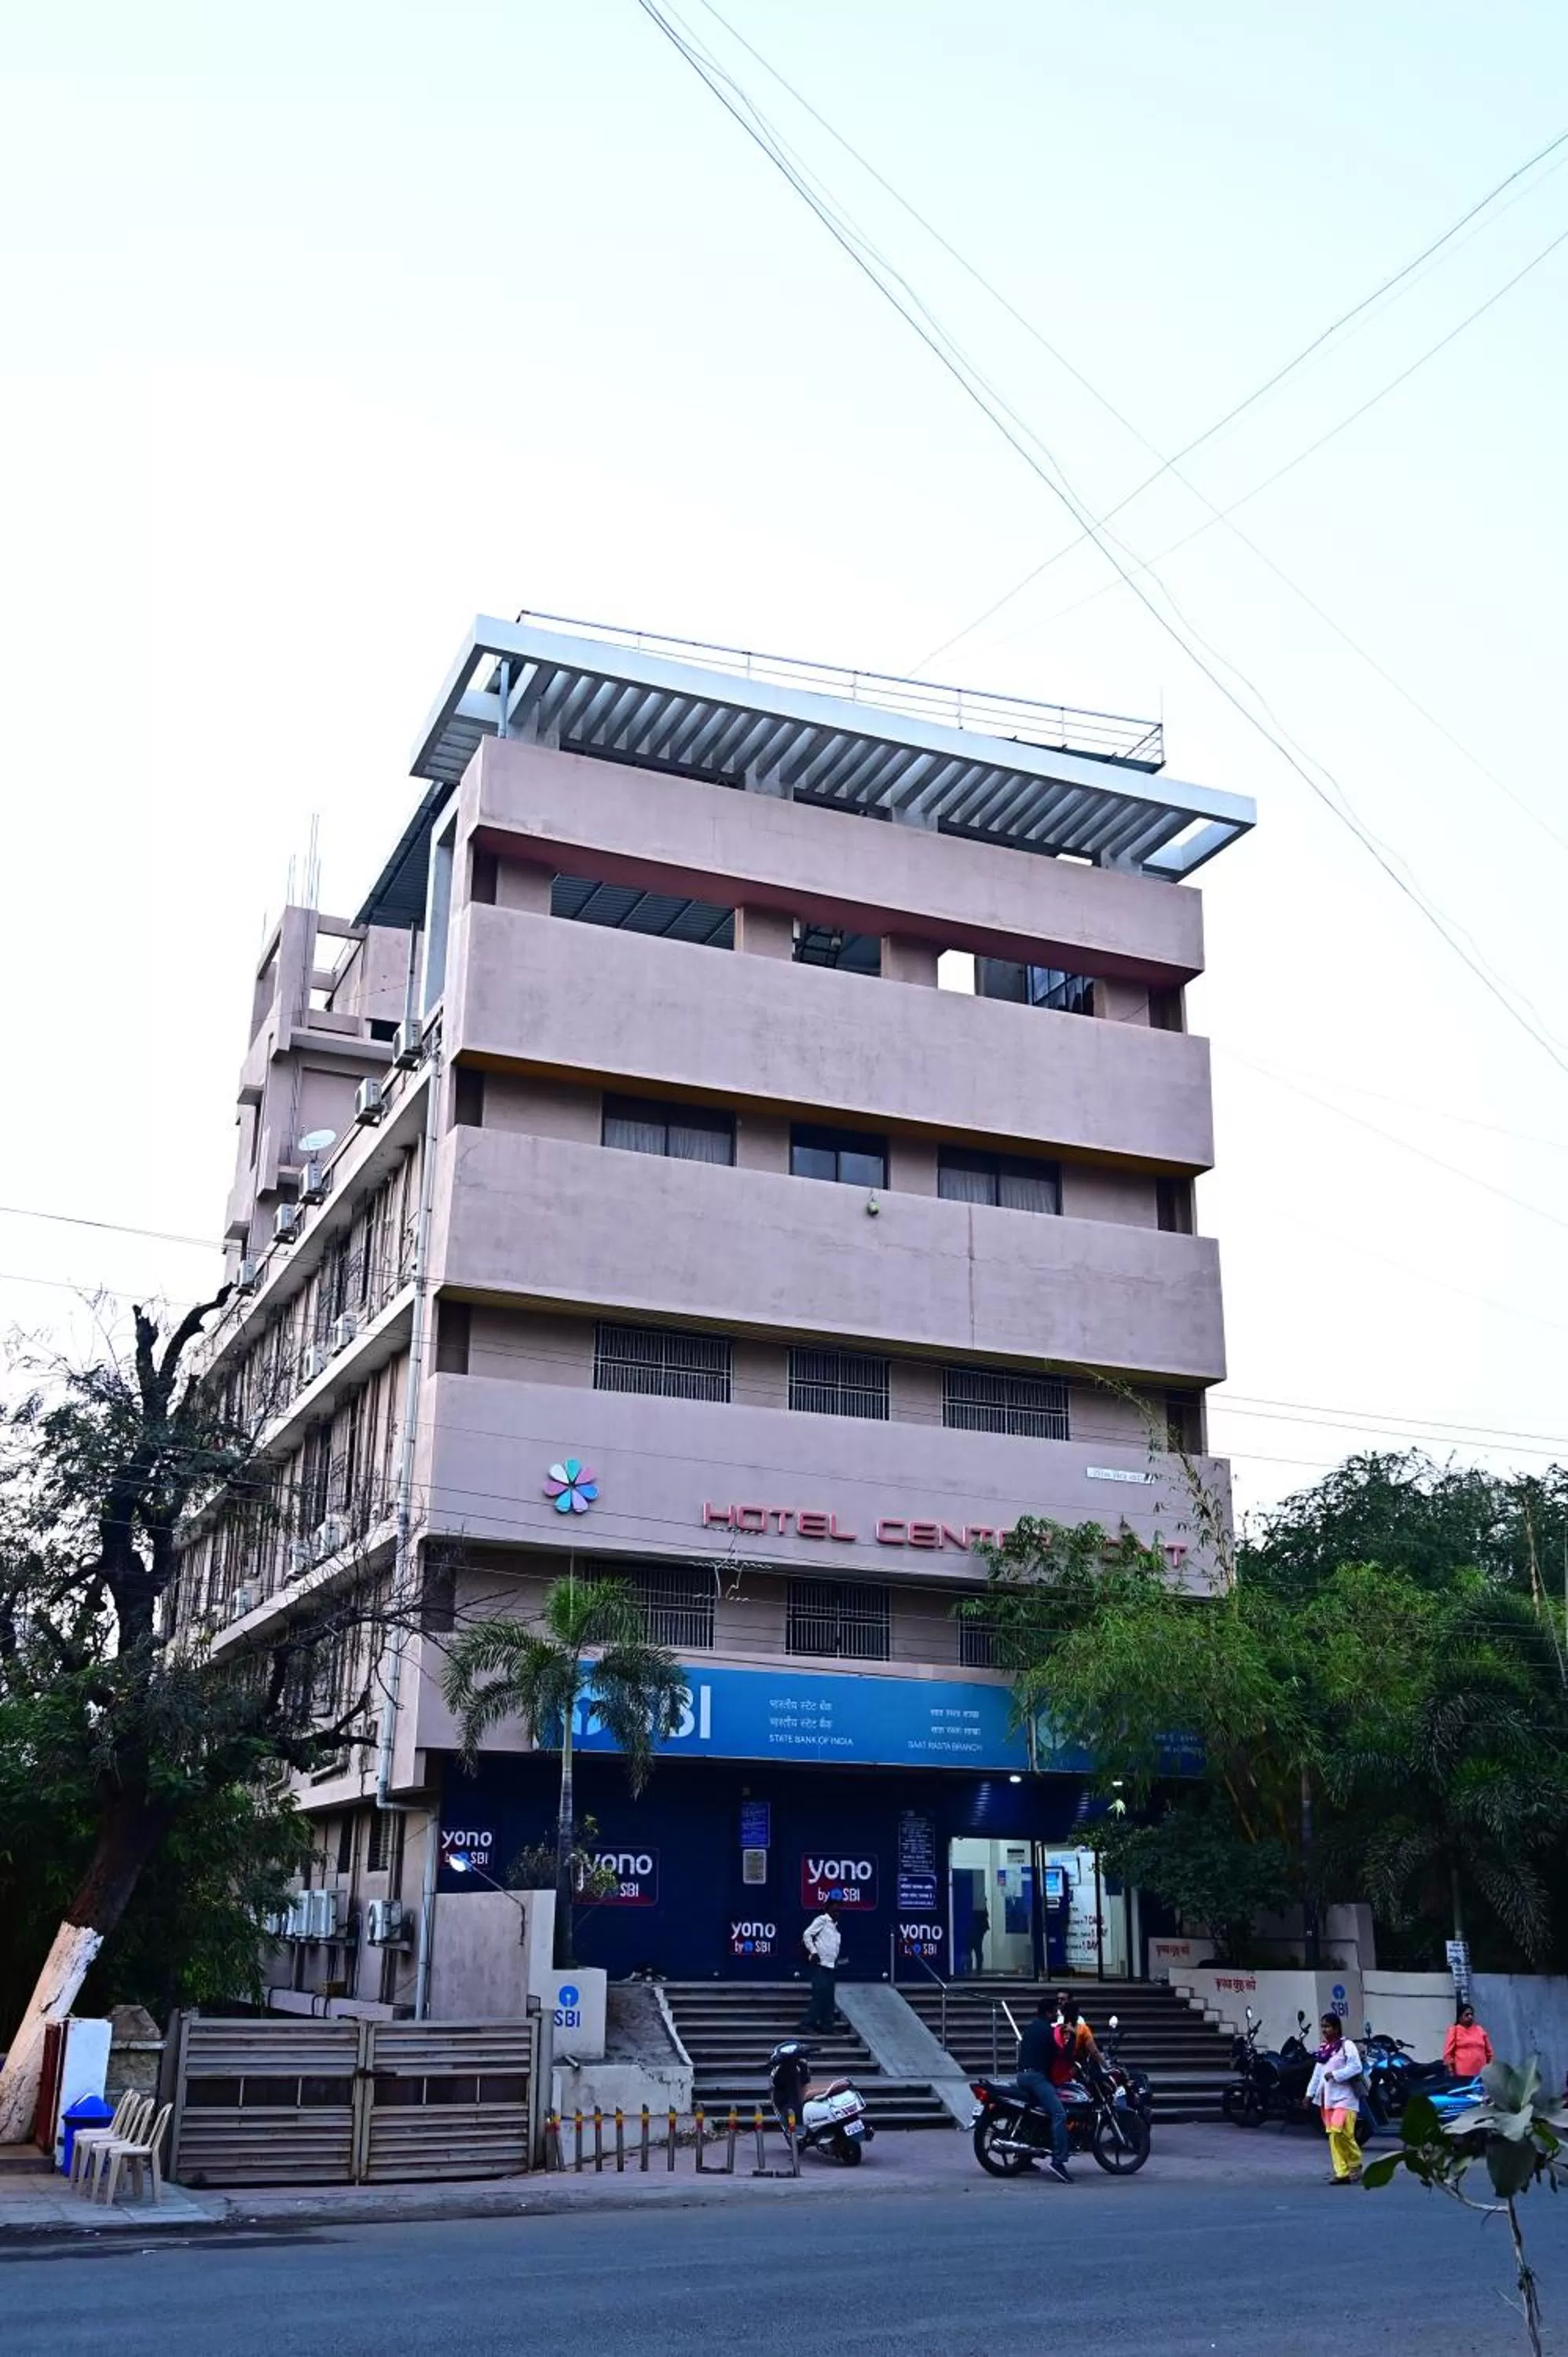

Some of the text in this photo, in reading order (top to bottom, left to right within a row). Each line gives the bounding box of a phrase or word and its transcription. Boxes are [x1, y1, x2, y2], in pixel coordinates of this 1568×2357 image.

[703, 1501, 856, 1541] HOTEL
[876, 1518, 1052, 1556] CENT
[769, 1733, 854, 1747] STATE BANK OF INDIA
[441, 1830, 493, 1849] yono
[471, 1850, 489, 1864] SBI
[807, 1858, 873, 1884] yono
[620, 1882, 639, 1897] SBI
[818, 1886, 860, 1903] by SBI
[731, 1922, 776, 1940] yono
[899, 1924, 943, 1940] yono
[755, 1941, 771, 1953] SBI
[922, 1943, 937, 1955] SBI
[1331, 2001, 1349, 2018] SBI
[553, 2009, 581, 2028] SBI
